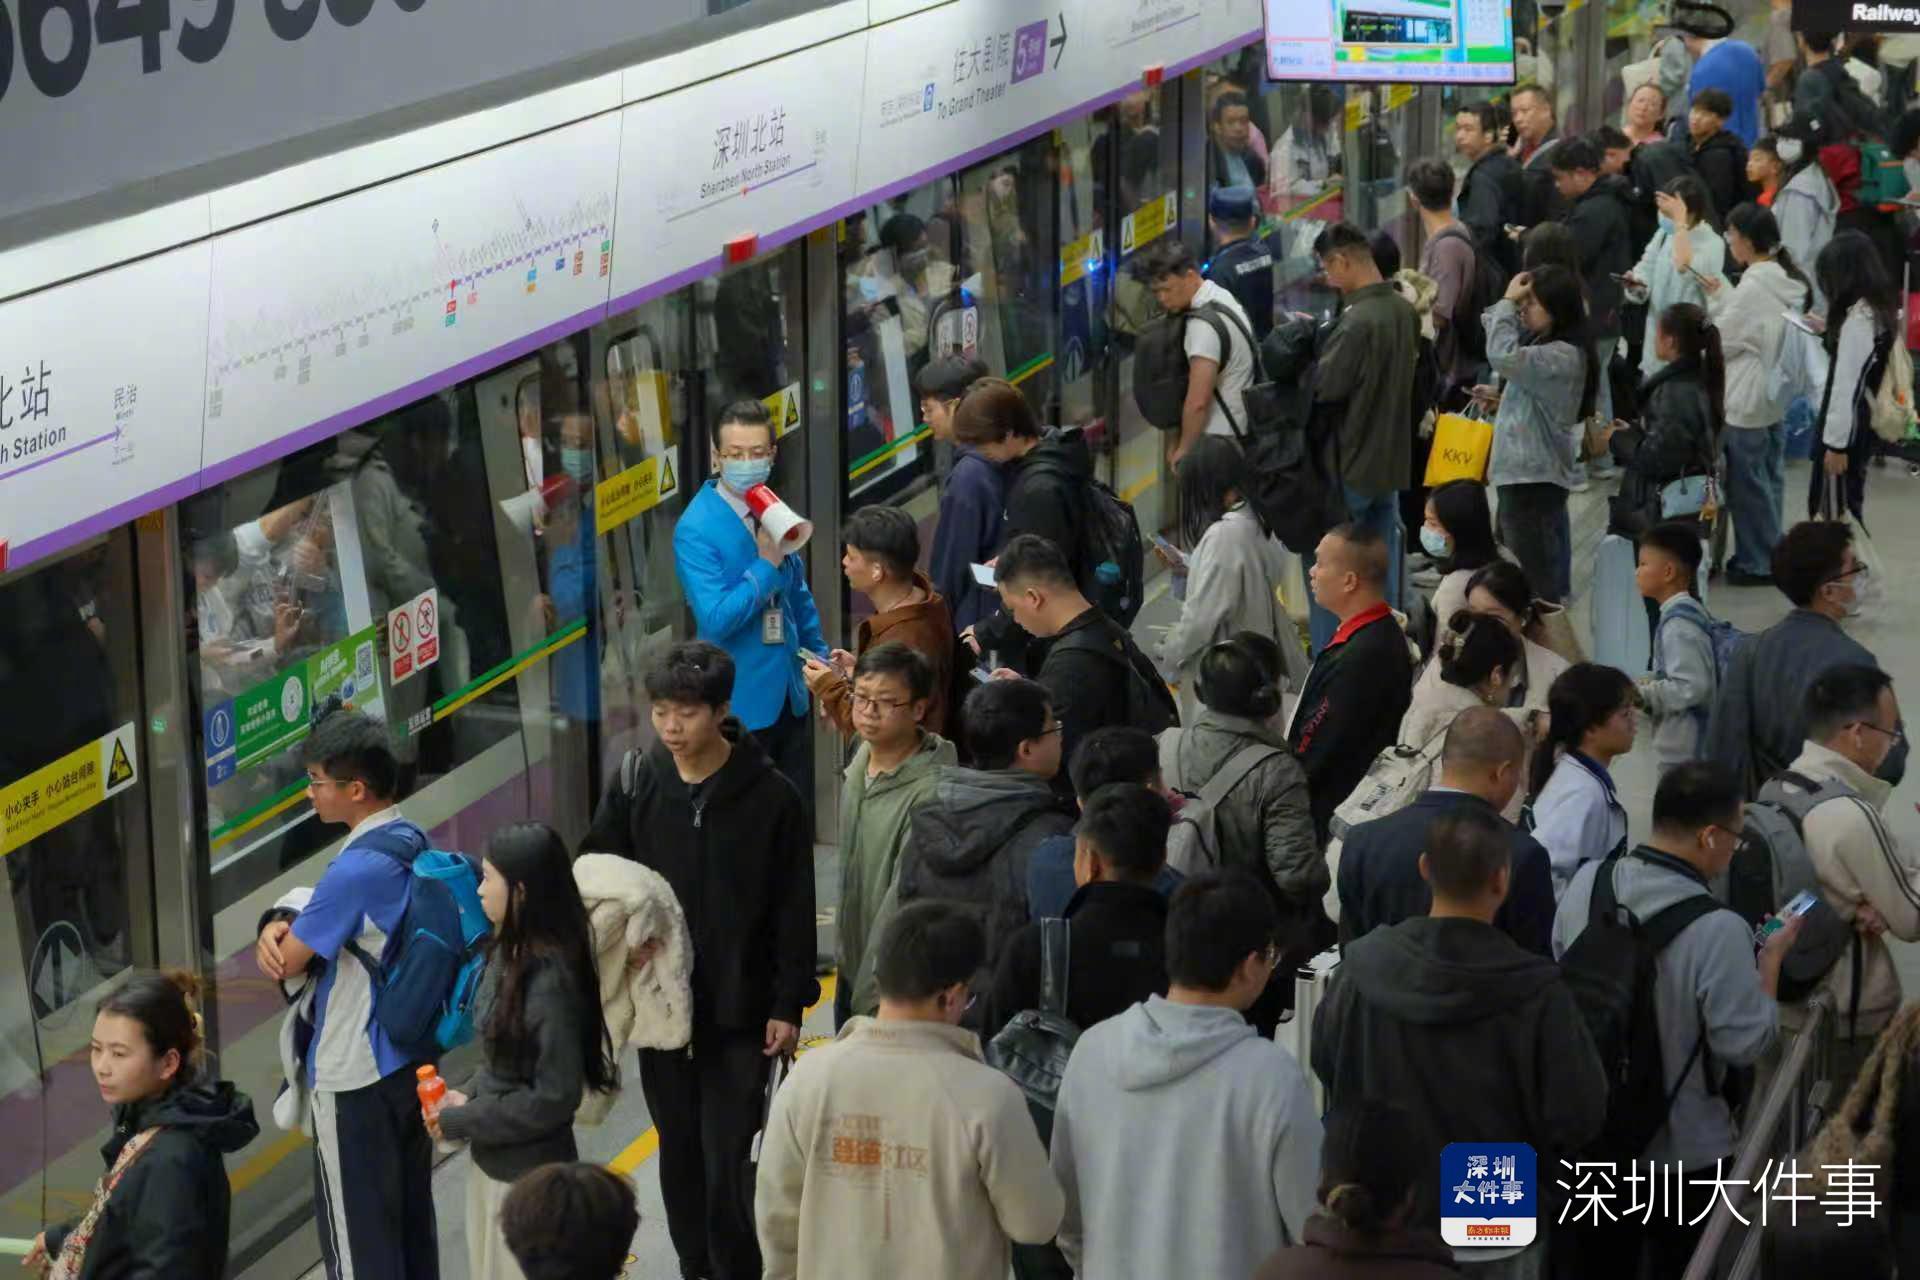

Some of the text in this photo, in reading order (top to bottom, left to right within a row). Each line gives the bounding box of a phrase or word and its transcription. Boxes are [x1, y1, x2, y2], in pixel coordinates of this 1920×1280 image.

[1853, 3, 1920, 26] Railway
[938, 101, 947, 120] To
[976, 80, 1007, 105] Theater
[712, 103, 787, 171] 深圳北站
[701, 153, 792, 199] Shenzhen North Station
[13, 426, 67, 460] Station
[1442, 447, 1473, 466] KKV
[5, 789, 40, 820] 小心夹手
